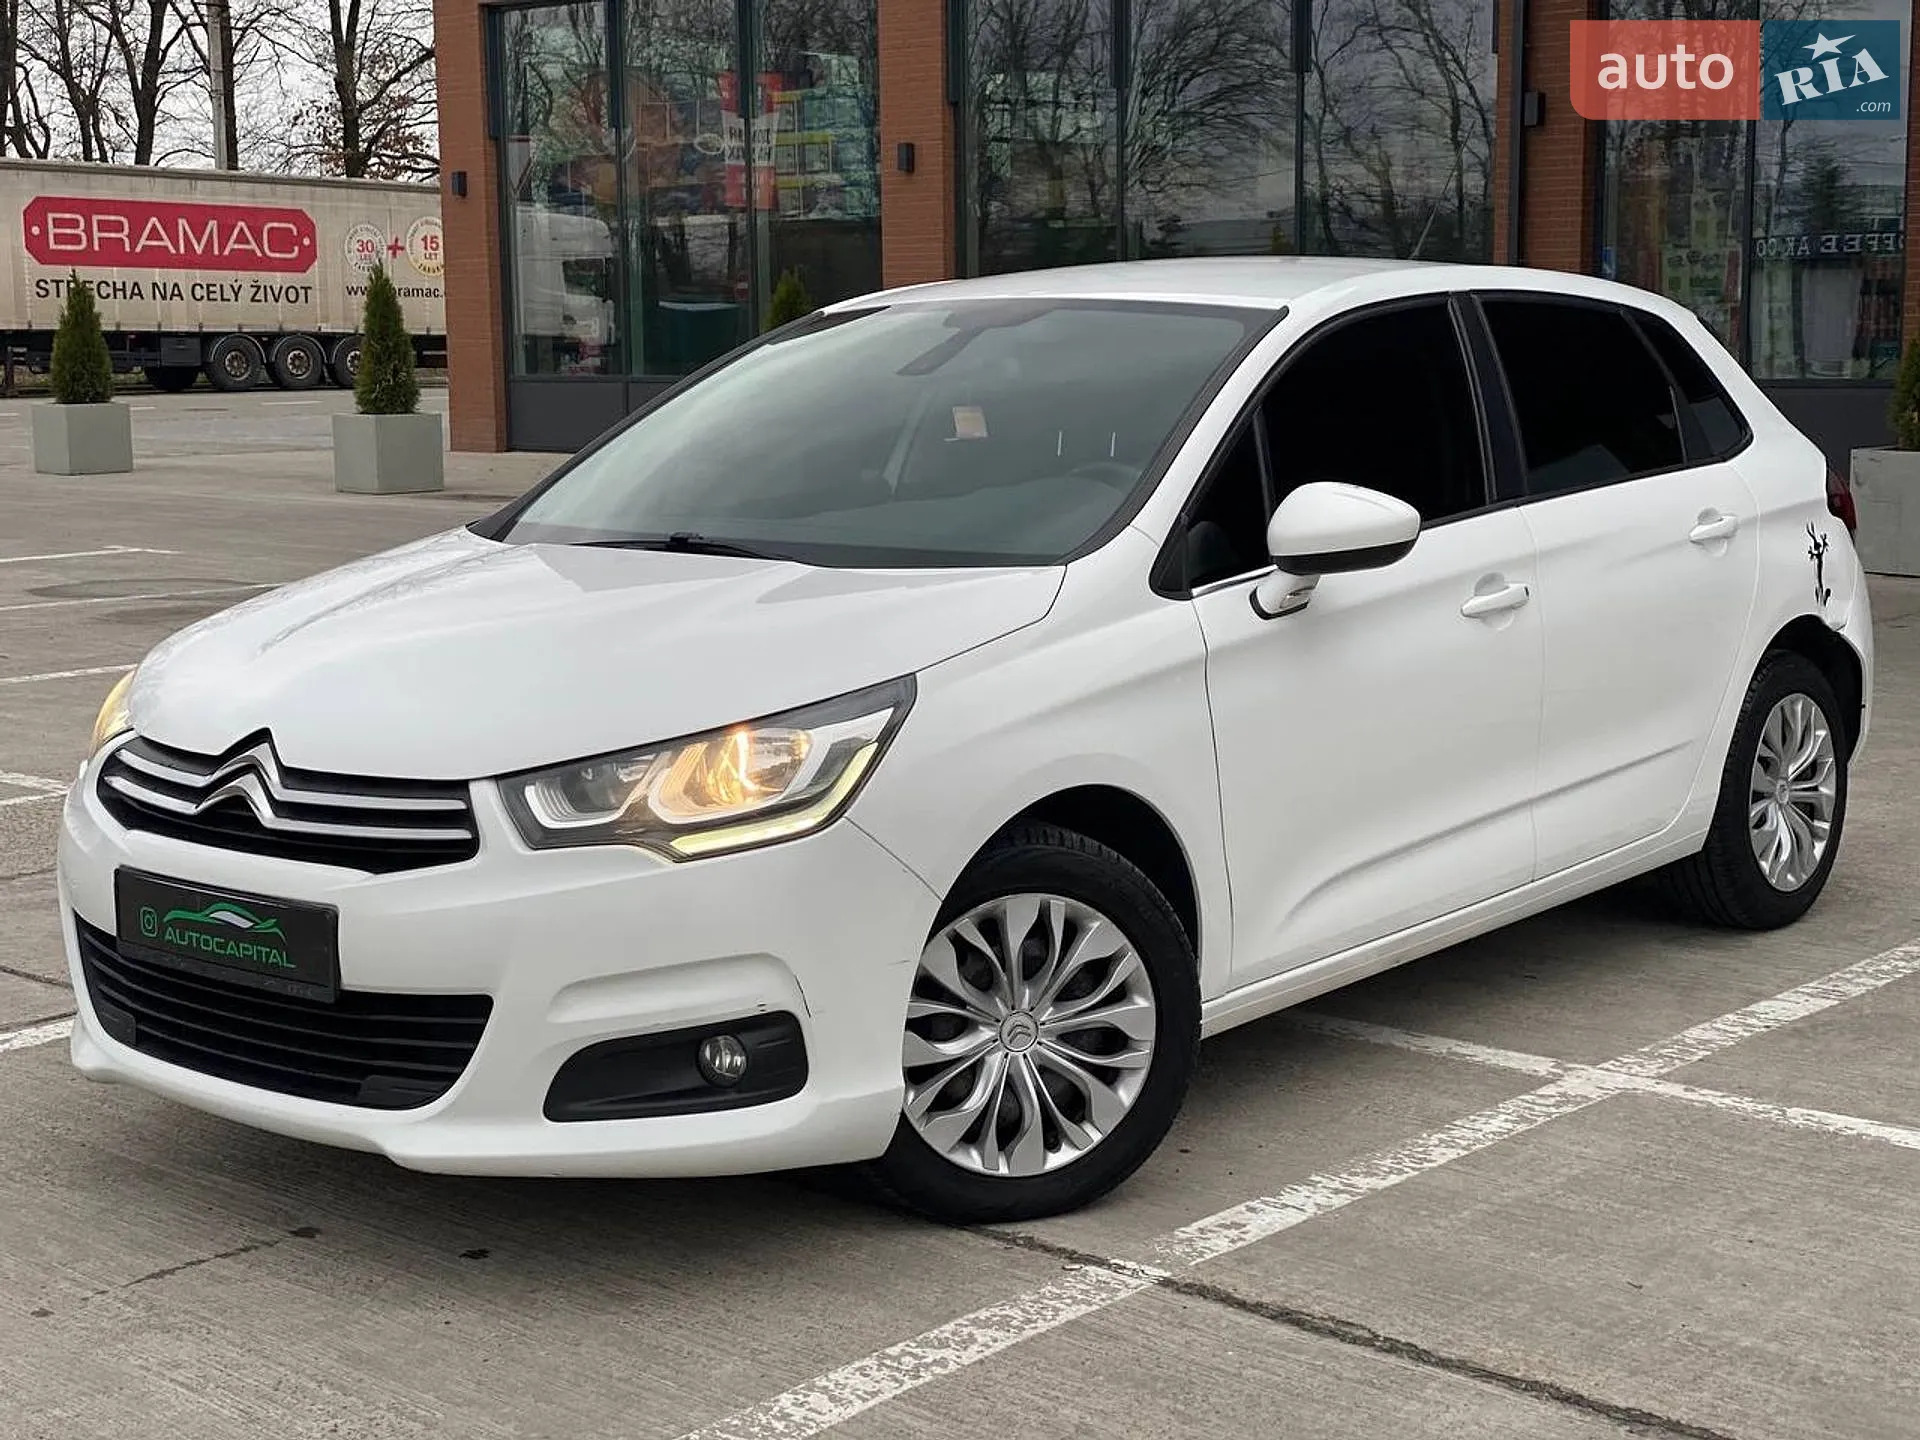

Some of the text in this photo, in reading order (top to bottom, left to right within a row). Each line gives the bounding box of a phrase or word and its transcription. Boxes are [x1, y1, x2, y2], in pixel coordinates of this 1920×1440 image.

[47, 212, 299, 259] BRAMAC
[356, 239, 375, 253] 30
[421, 234, 440, 252] 15
[151, 281, 184, 302] NA
[191, 279, 243, 303] CELÝ
[250, 280, 313, 305] ŽIVOT
[164, 926, 297, 968] AUTOCAPITAL
